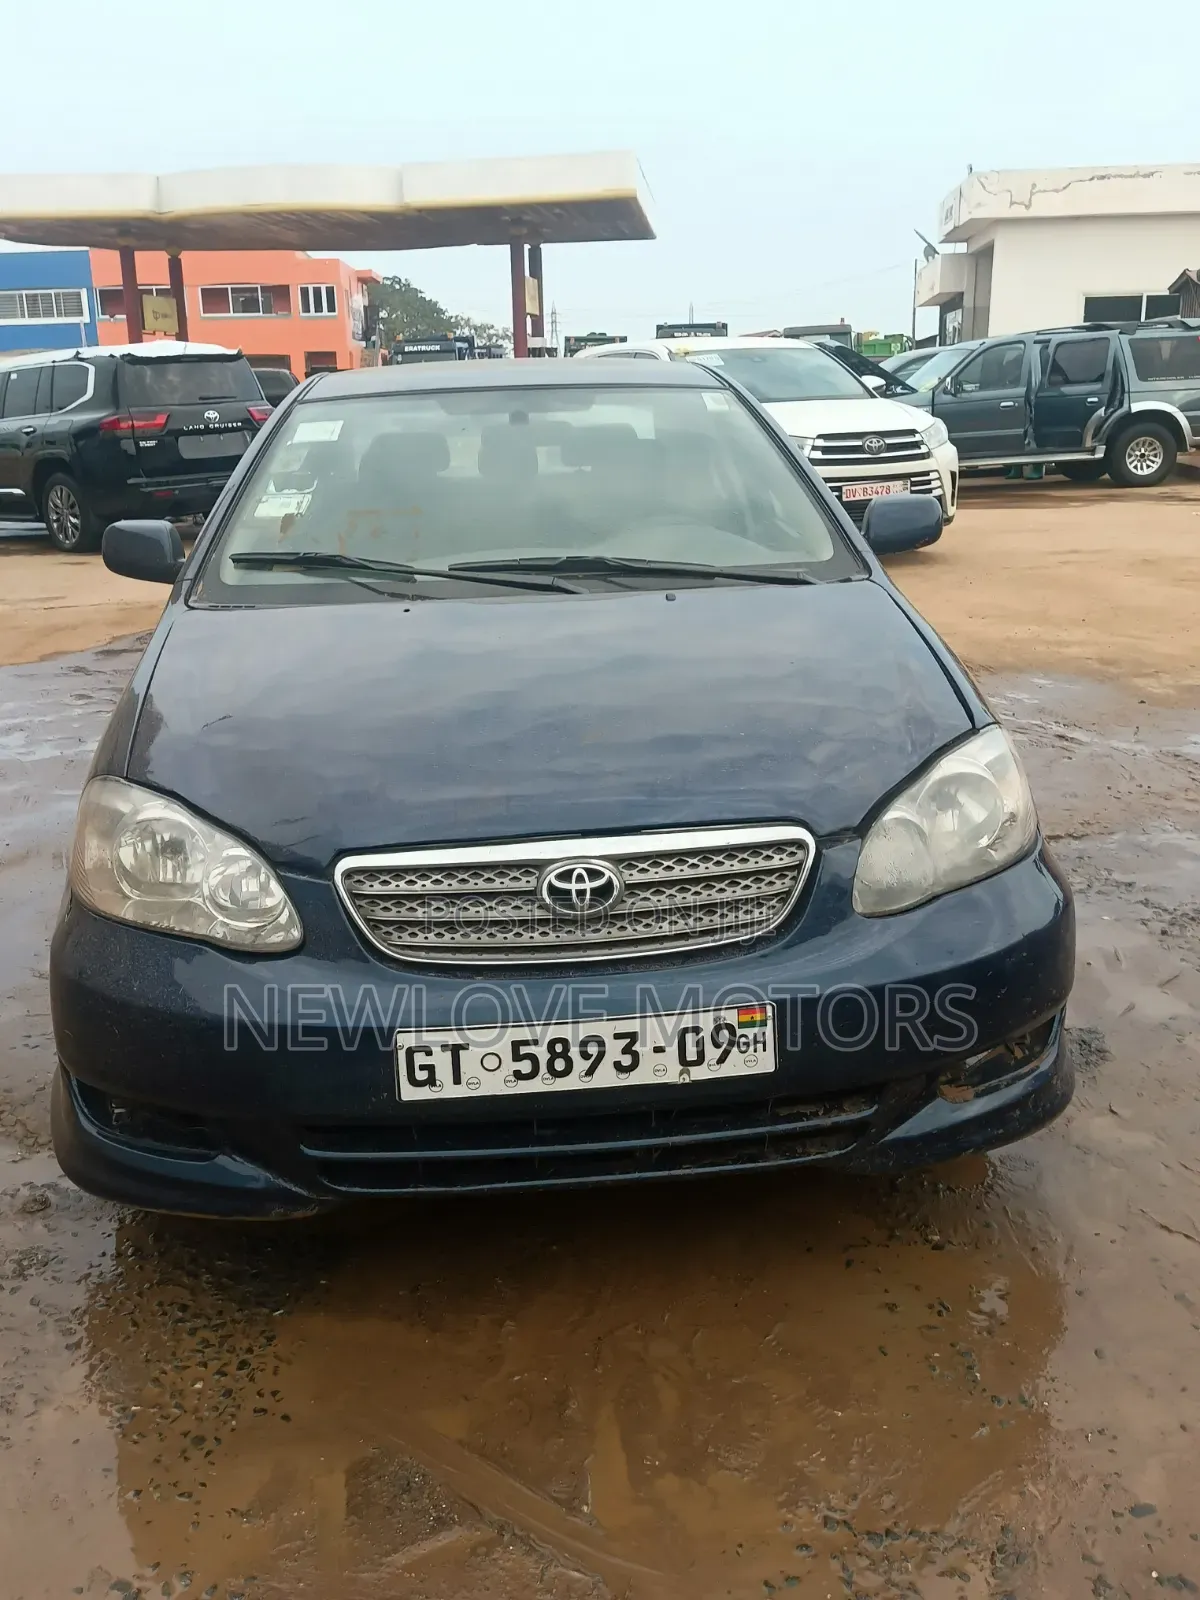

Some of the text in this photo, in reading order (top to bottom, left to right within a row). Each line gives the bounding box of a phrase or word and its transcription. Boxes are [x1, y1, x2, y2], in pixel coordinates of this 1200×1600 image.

[845, 488, 857, 499] DV
[736, 1031, 767, 1054] GH
[405, 1042, 470, 1088] GT
